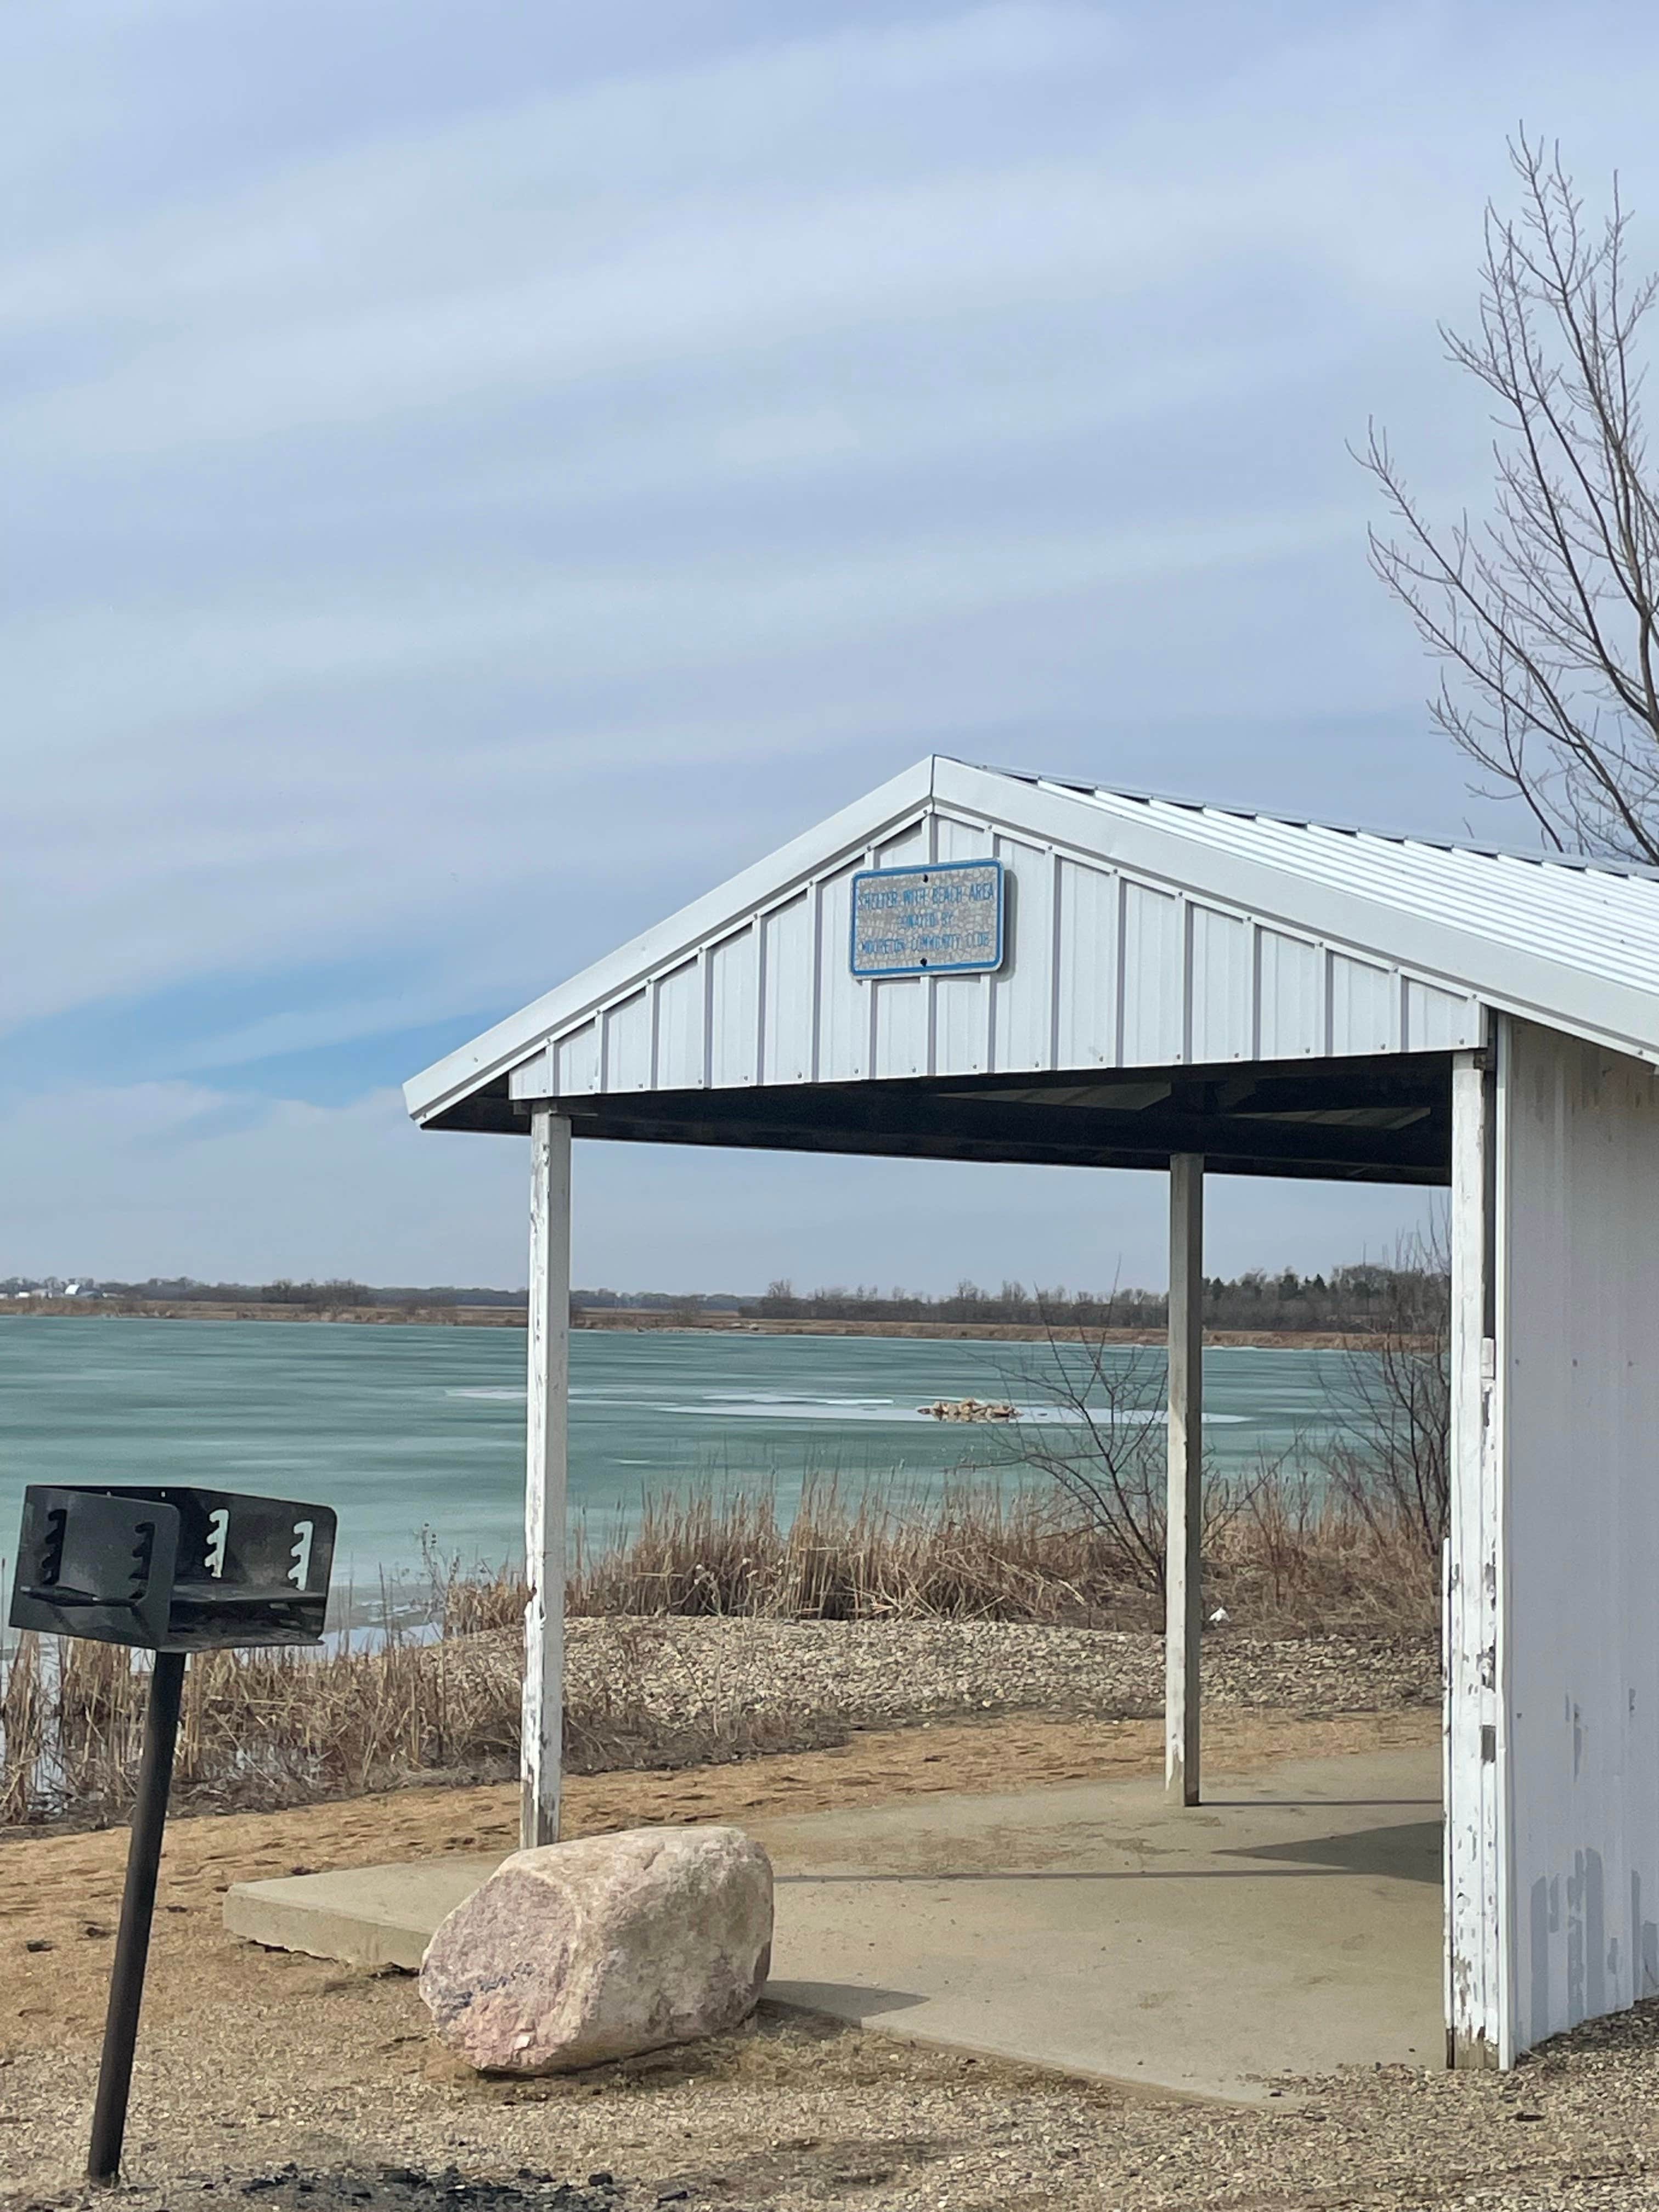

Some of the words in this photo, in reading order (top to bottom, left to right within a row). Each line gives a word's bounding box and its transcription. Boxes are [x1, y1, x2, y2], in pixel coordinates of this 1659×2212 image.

[858, 890, 898, 910] SHELTER
[903, 888, 926, 904] WITH
[933, 884, 962, 904] BEACH
[969, 882, 994, 901] AREA
